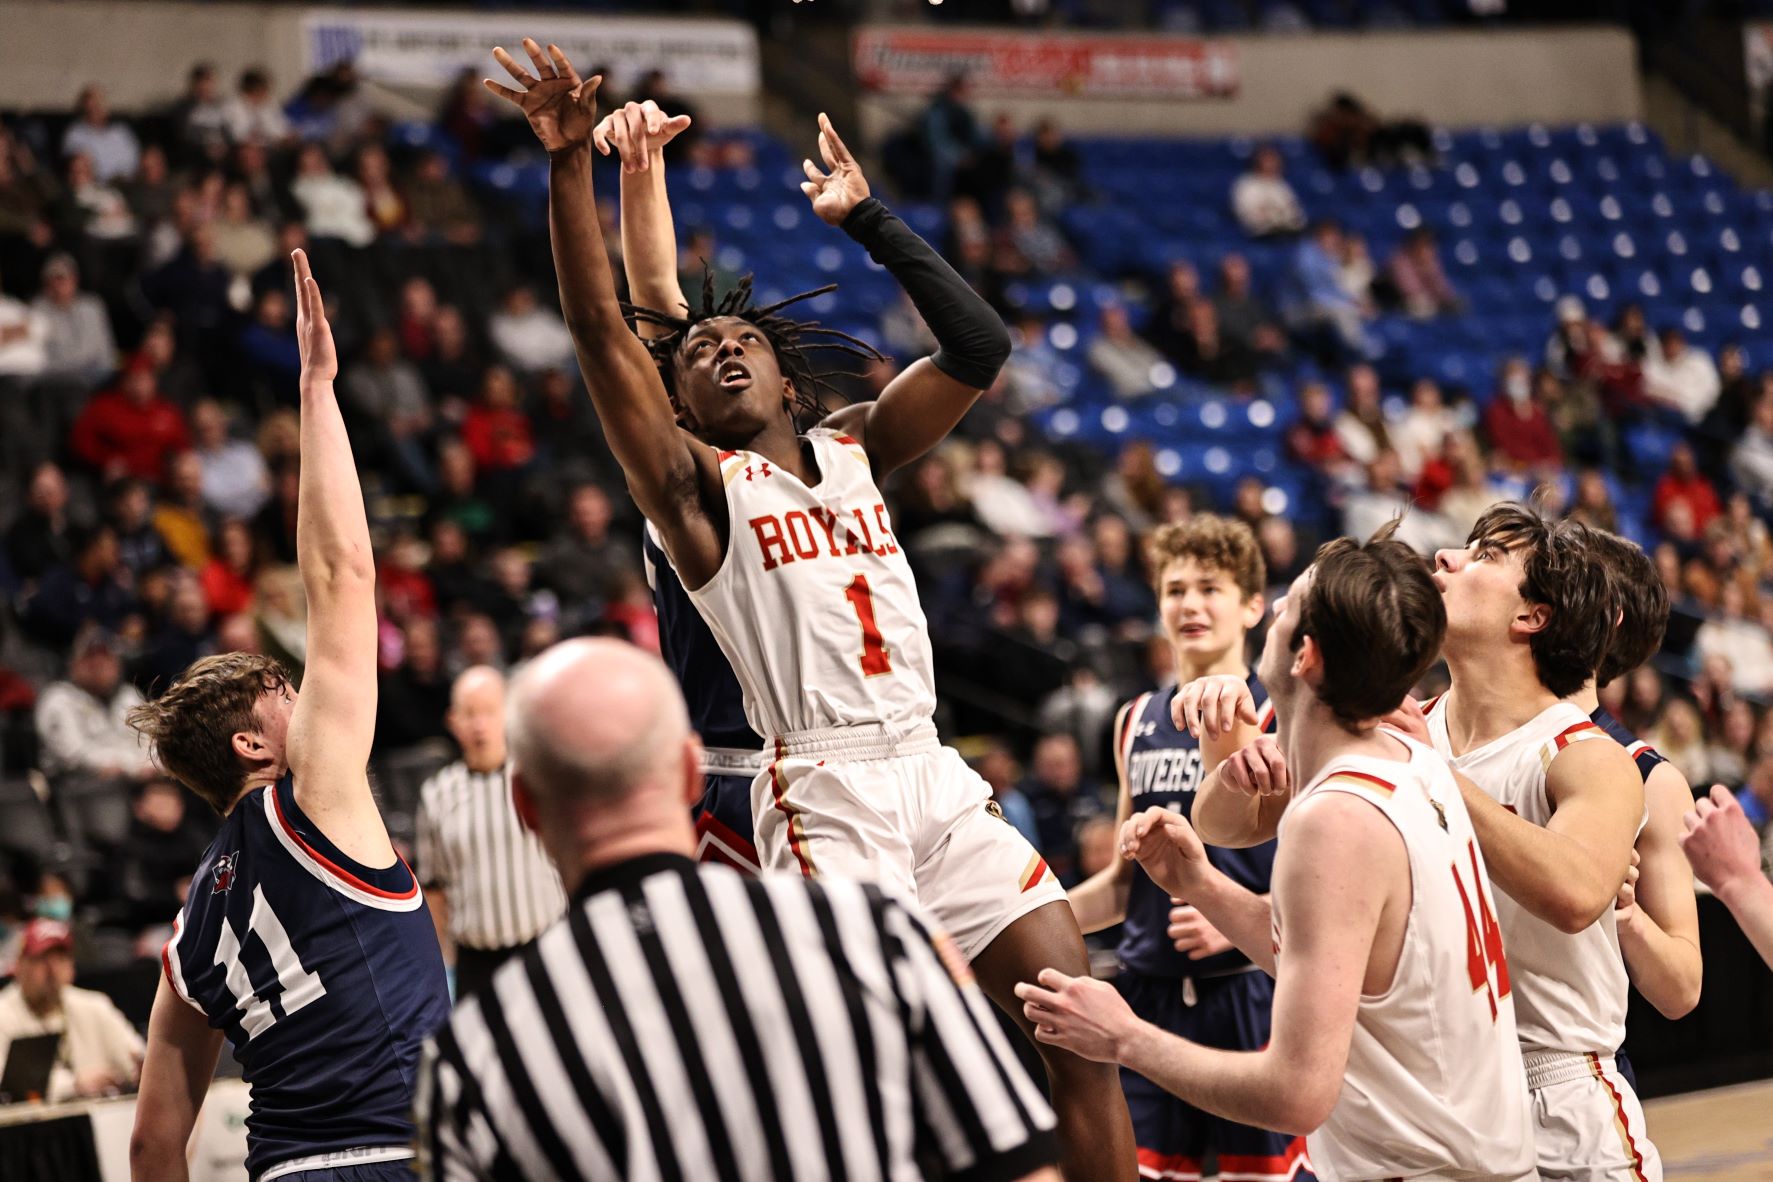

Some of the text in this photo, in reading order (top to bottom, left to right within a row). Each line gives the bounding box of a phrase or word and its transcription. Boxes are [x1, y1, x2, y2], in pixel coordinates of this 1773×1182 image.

[842, 572, 894, 679] 1
[213, 882, 327, 1041] 11
[1450, 836, 1511, 1026] 44
